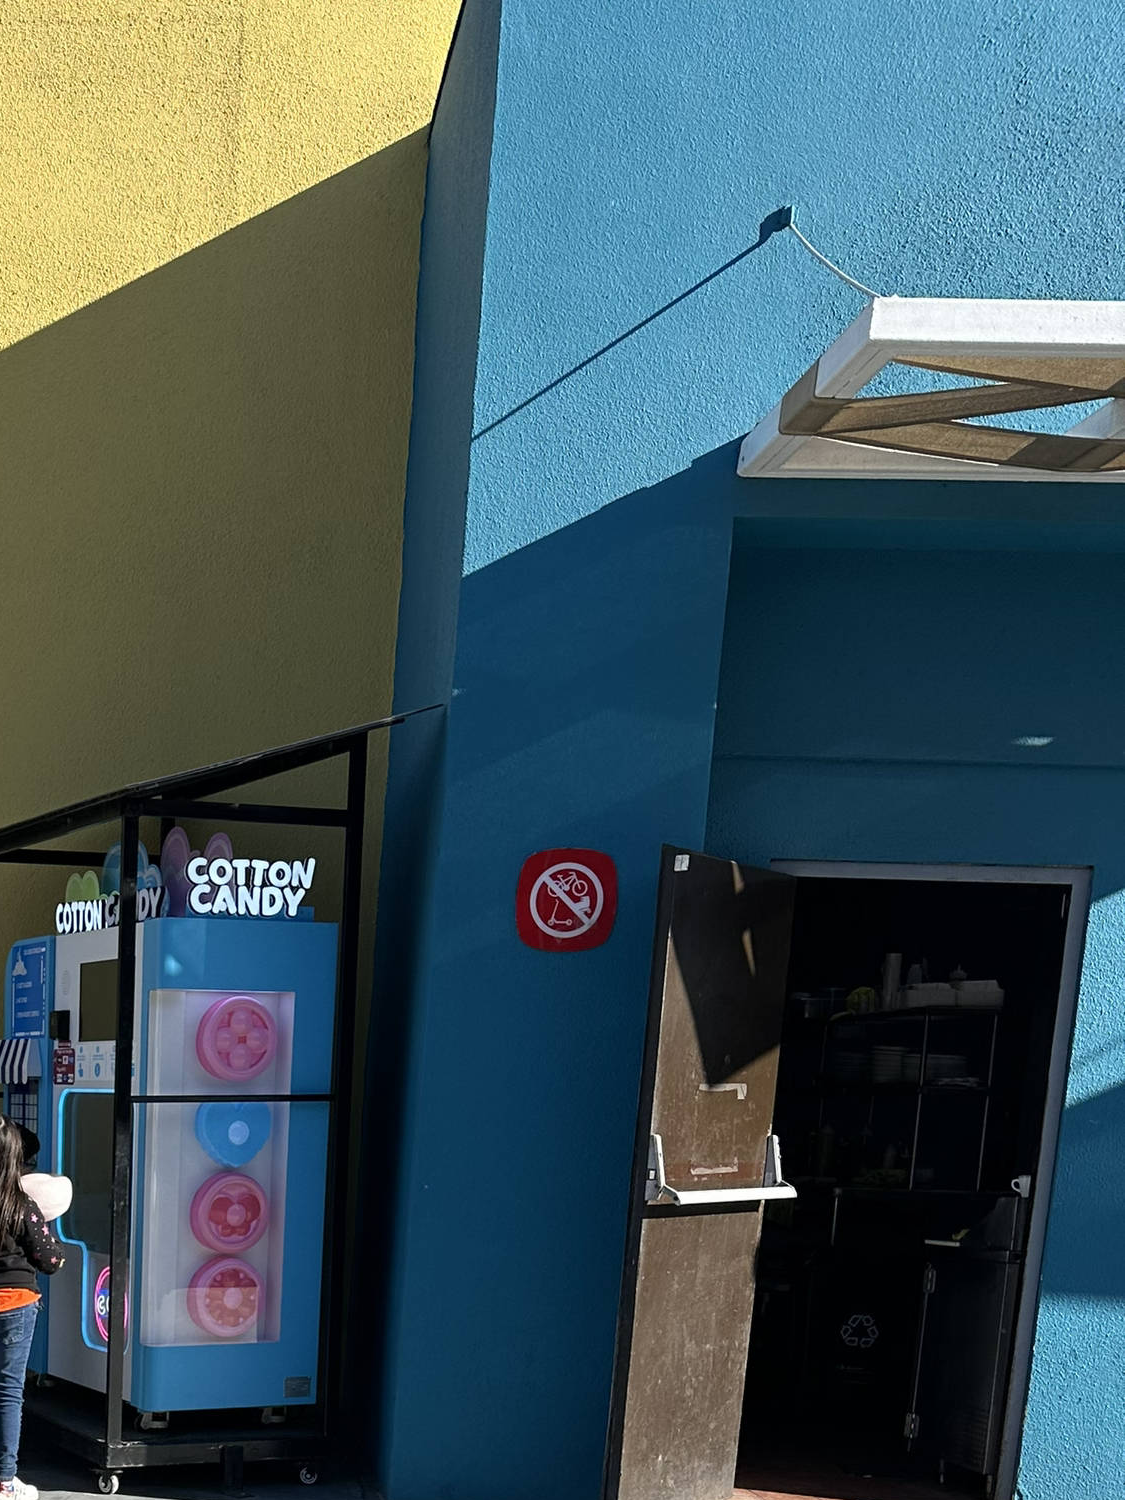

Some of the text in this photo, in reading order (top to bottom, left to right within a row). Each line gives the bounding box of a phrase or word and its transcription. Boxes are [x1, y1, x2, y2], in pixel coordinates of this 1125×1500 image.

[187, 857, 316, 889] COTTON
[55, 887, 161, 934] COTTON CDY
[189, 884, 306, 917] CANDY
